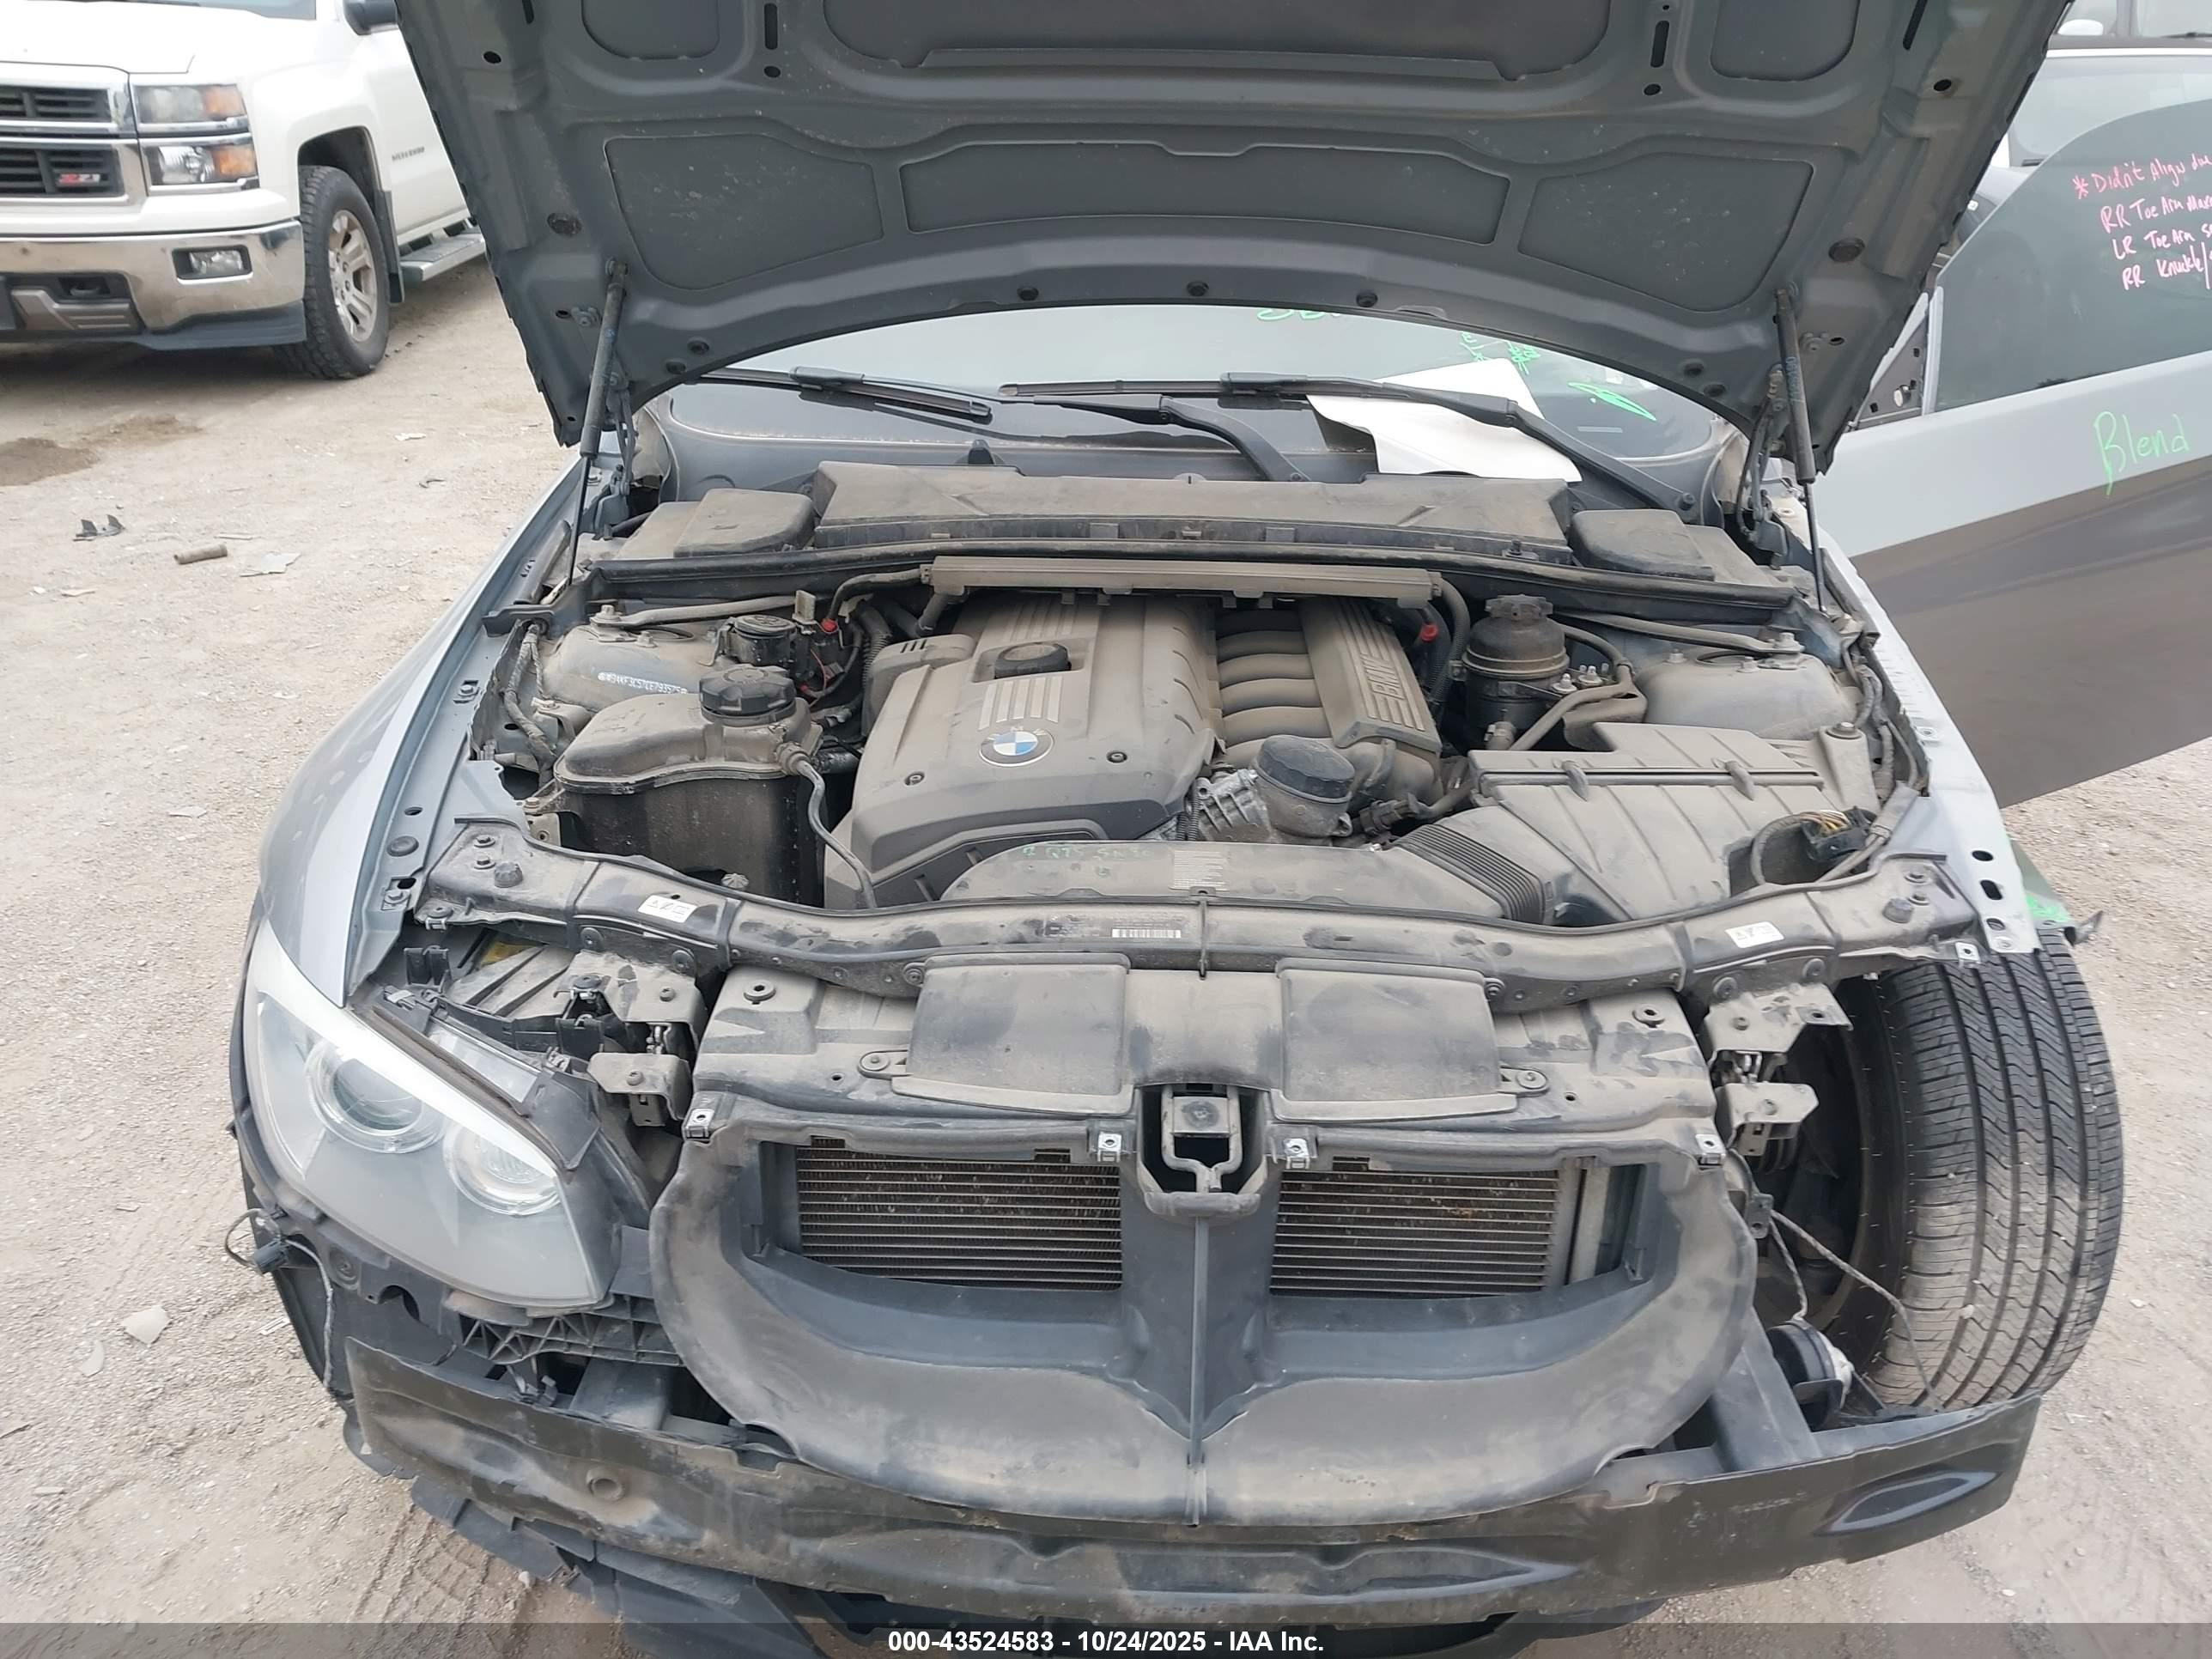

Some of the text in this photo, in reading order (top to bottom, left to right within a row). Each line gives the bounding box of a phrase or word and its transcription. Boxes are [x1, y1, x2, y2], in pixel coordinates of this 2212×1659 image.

[2100, 204, 2131, 234] RR
[2112, 235, 2136, 260] LR
[2122, 264, 2146, 290] RR
[2093, 410, 2190, 495] Blend
